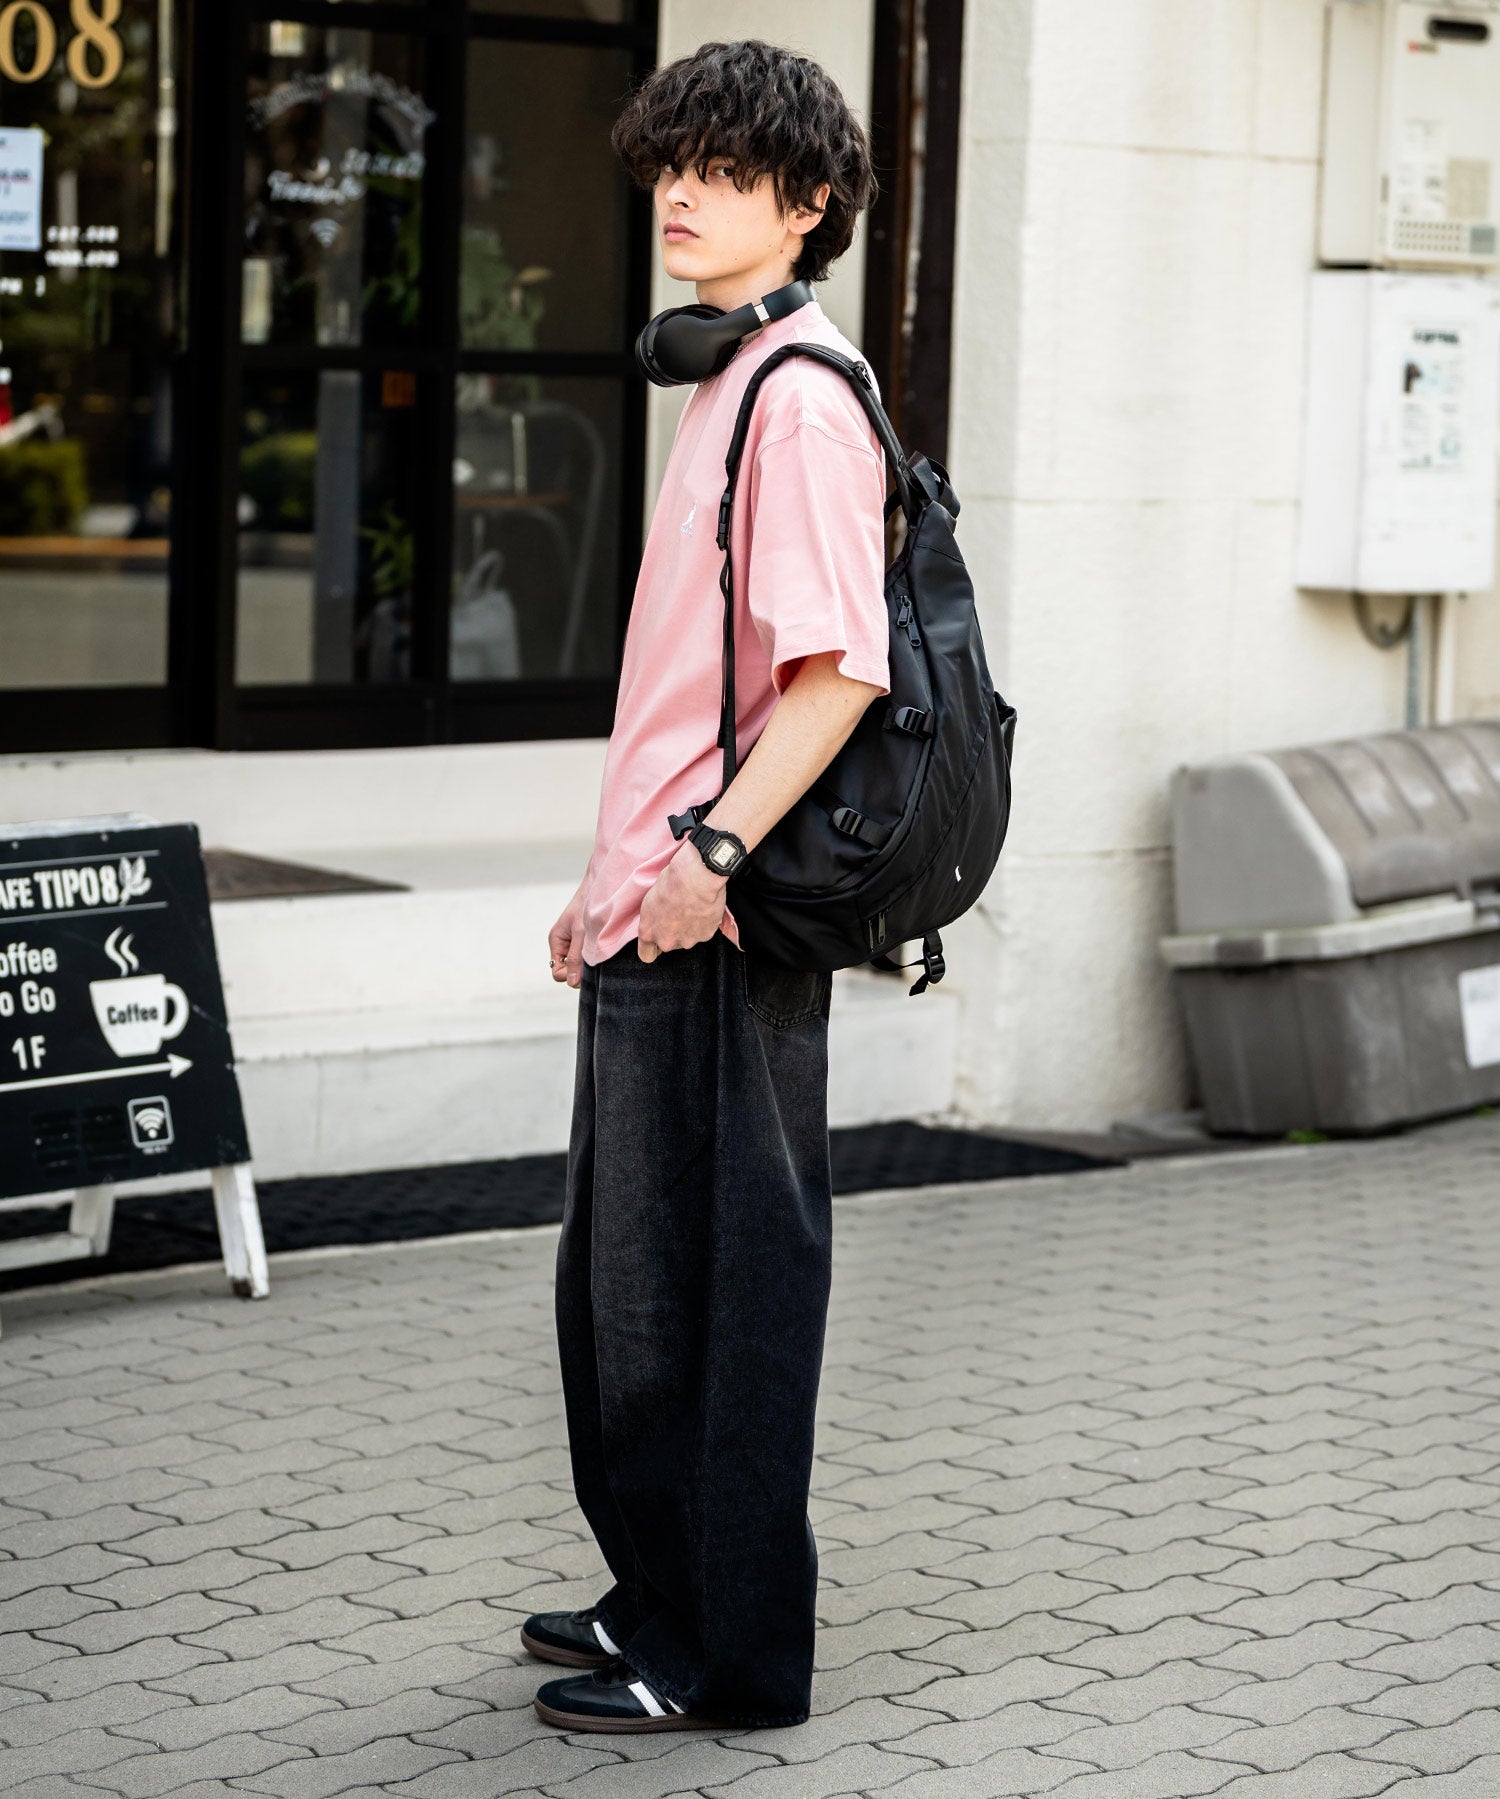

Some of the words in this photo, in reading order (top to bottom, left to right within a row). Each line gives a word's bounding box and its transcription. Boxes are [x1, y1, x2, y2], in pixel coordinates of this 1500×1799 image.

[20, 980, 57, 1014] Go
[106, 1003, 159, 1026] Coffee
[11, 1034, 47, 1071] 1F
